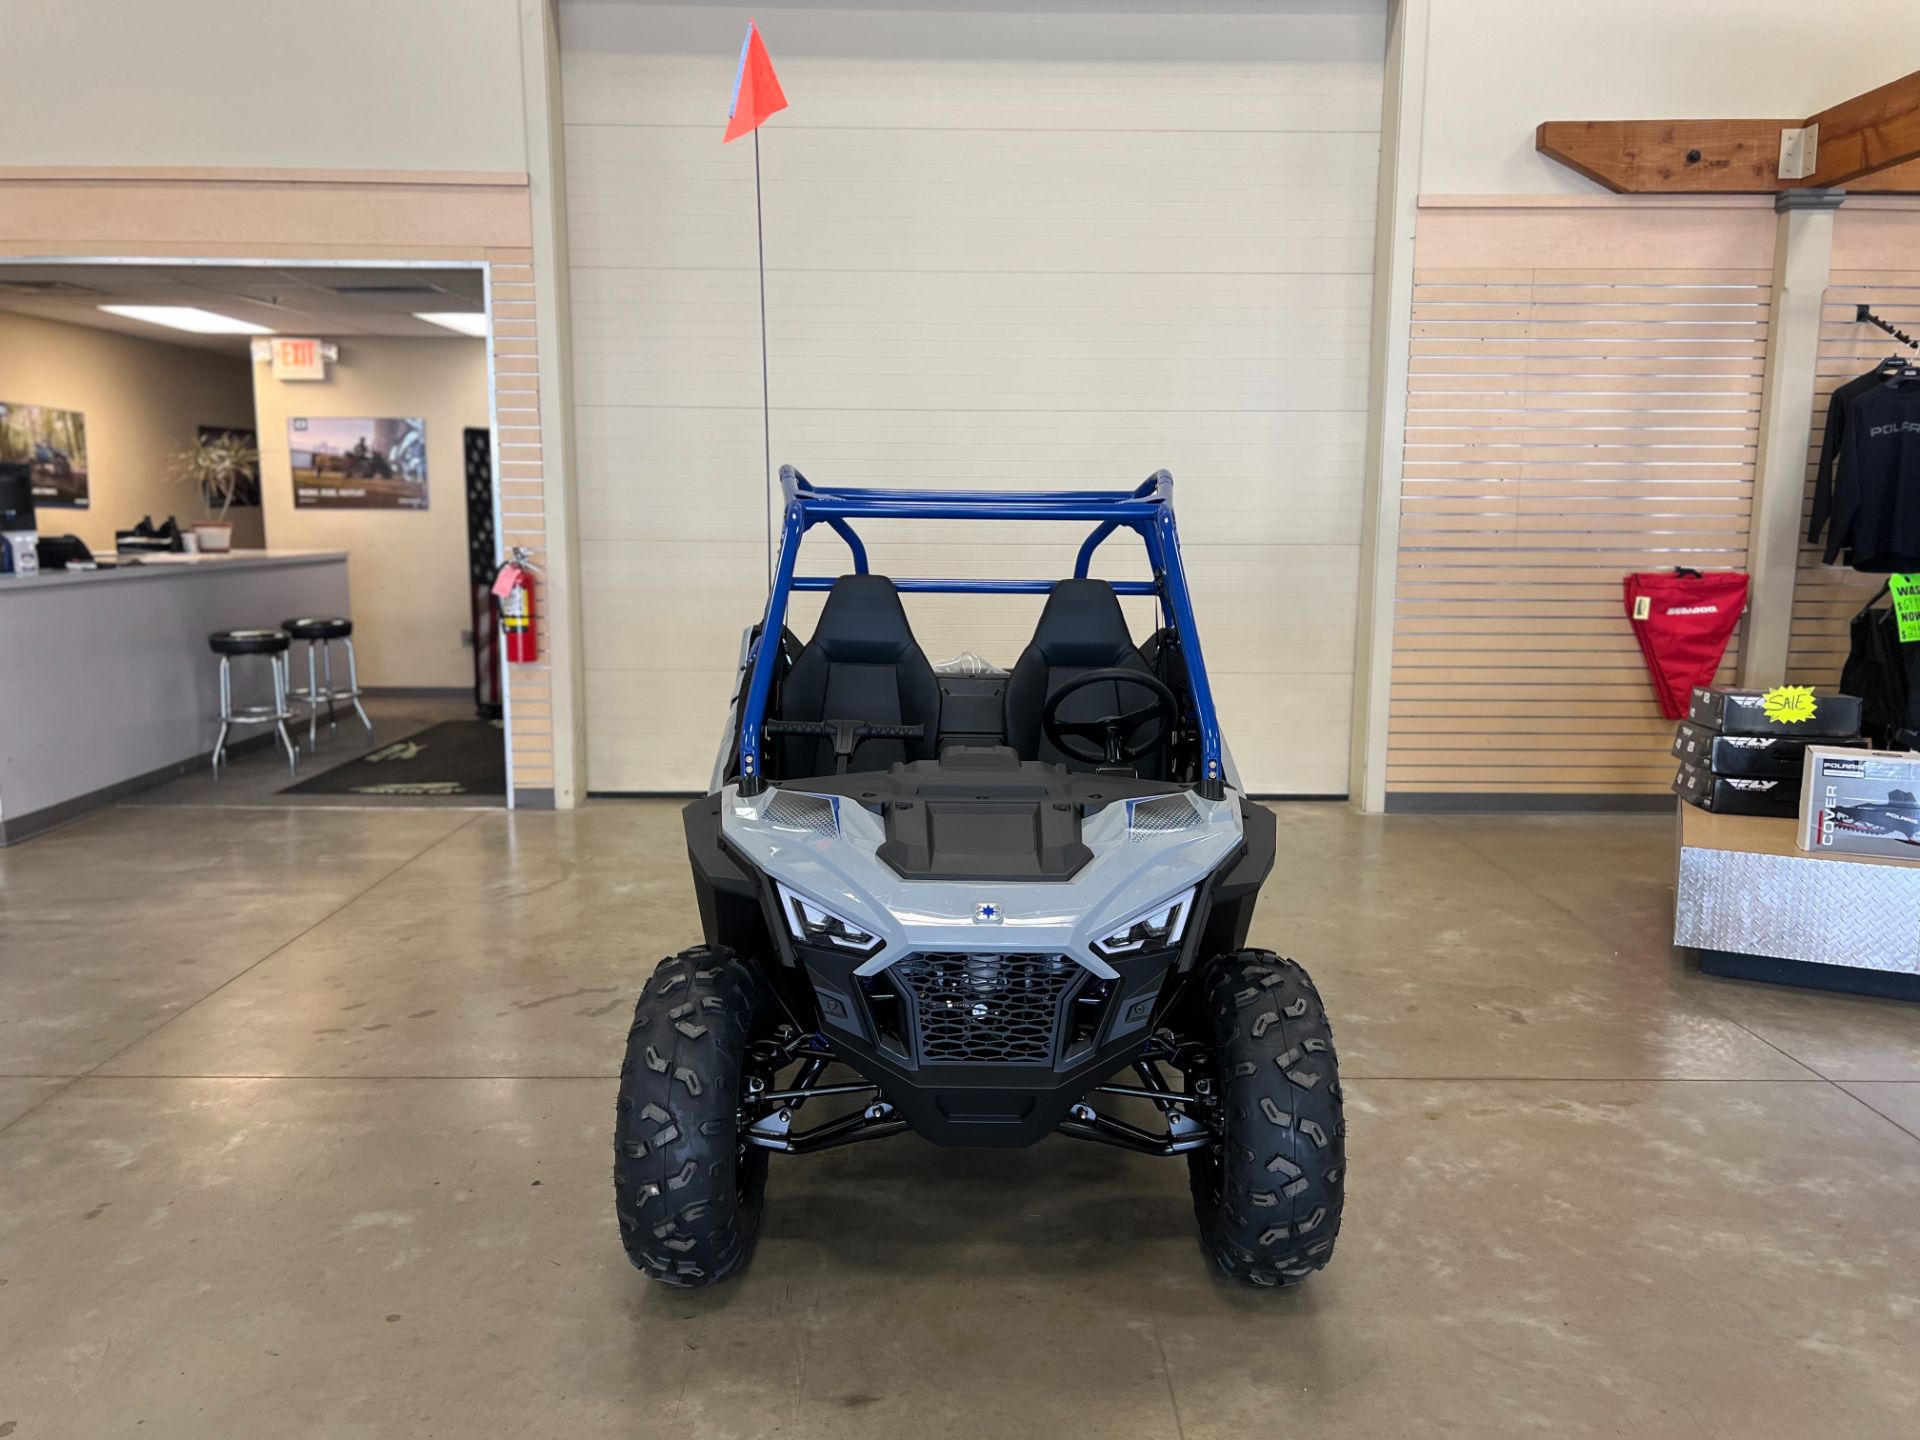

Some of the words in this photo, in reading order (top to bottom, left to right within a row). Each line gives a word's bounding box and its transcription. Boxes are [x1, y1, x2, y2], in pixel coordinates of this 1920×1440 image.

[282, 341, 315, 367] EXIT
[1896, 586, 1920, 596] WAS
[1723, 736, 1777, 747] FLY
[1823, 762, 1864, 771] POLARIS
[1725, 778, 1779, 790] FLY
[1823, 785, 1838, 846] COVER
